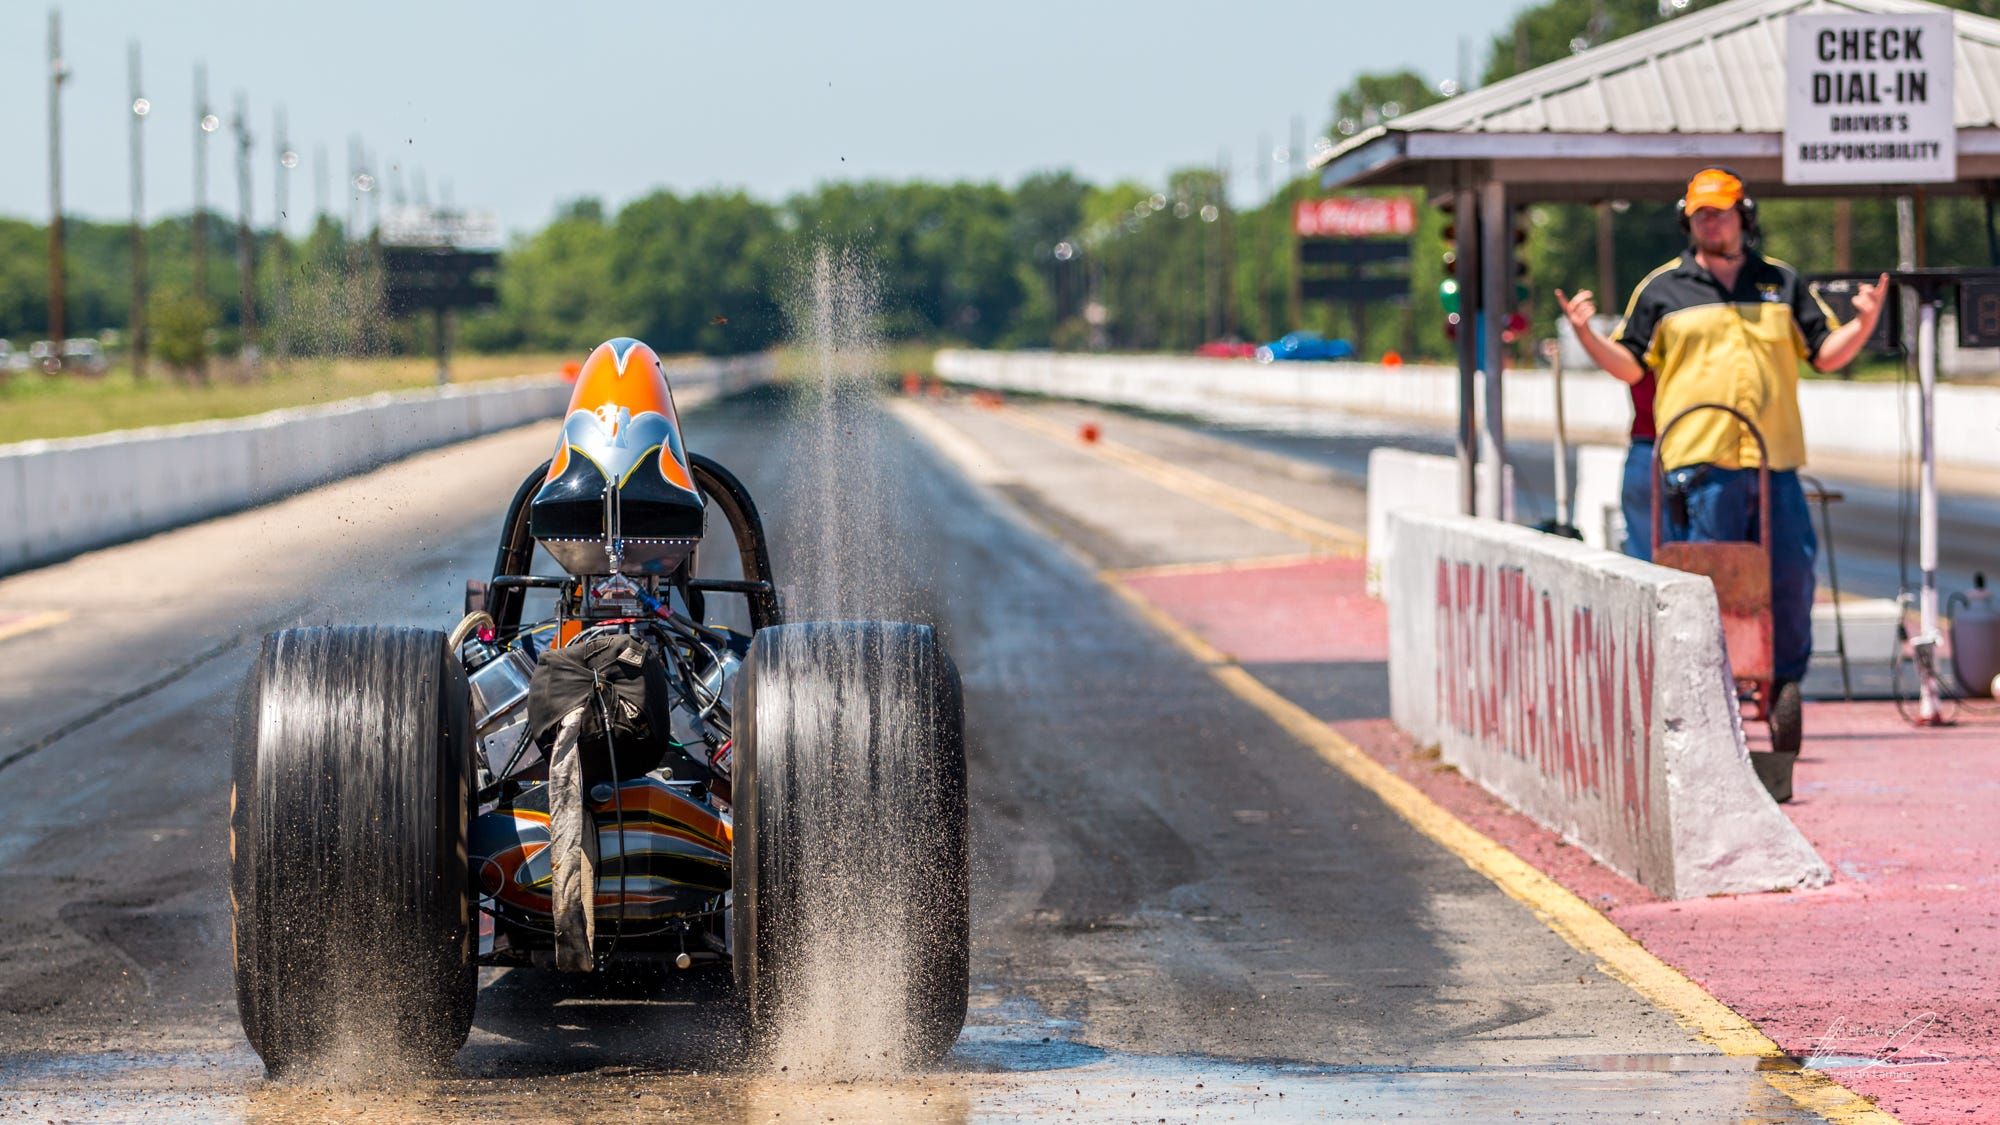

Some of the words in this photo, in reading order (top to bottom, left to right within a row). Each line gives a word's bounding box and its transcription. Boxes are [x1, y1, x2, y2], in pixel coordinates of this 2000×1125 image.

[1817, 28, 1923, 62] CHECK
[1812, 70, 1928, 104] DIAL-IN
[1830, 113, 1910, 133] DRIVER'S
[1799, 141, 1940, 162] RESPONSIBILITY
[1541, 588, 1655, 845] RACEWAY
